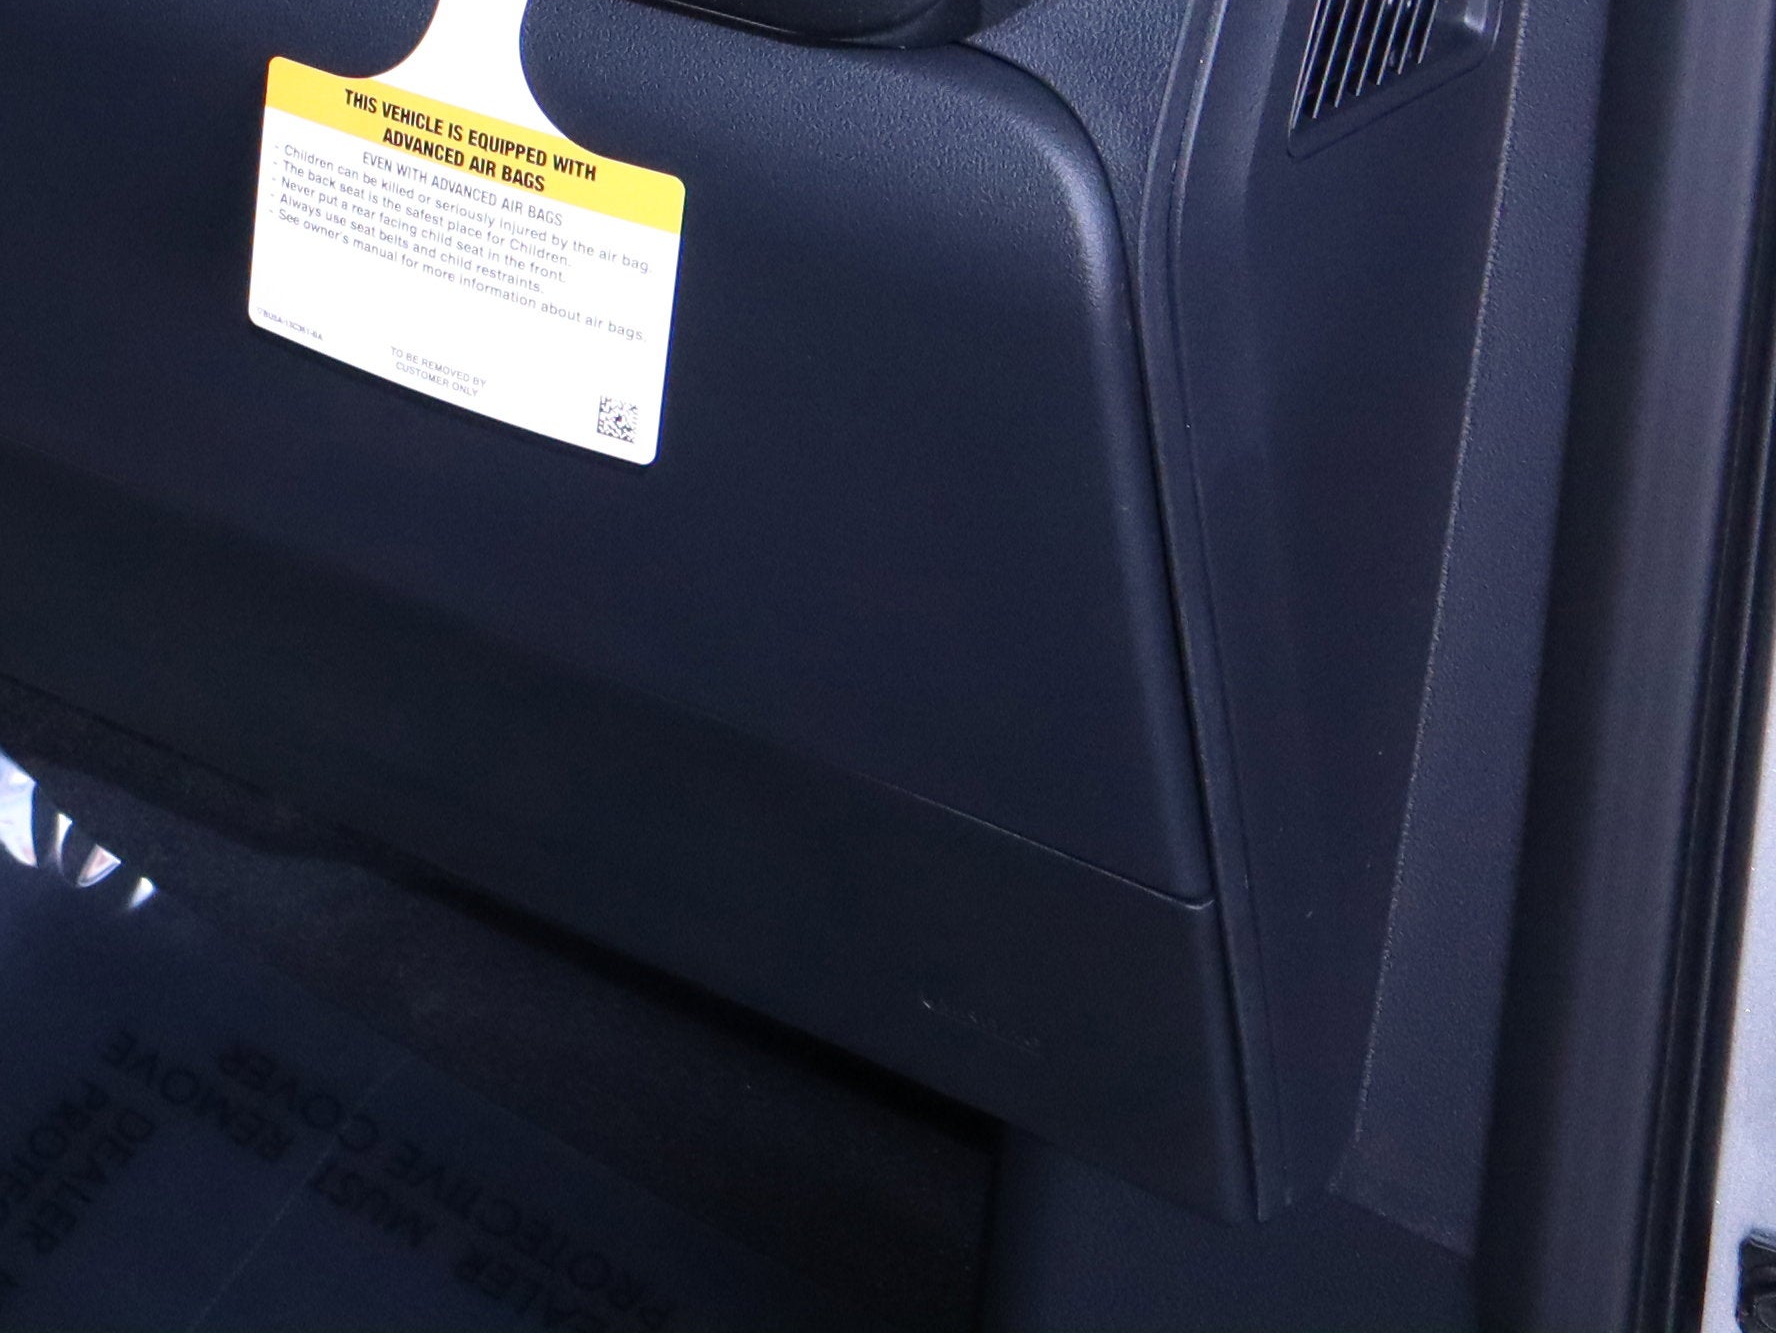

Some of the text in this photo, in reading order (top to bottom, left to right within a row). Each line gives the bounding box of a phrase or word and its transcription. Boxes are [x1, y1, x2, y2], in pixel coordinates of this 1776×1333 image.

[345, 88, 596, 181] THIS VEHICLE IS EQUIPPED WITH
[382, 127, 545, 192] ADVANCED AIR BAGS
[281, 176, 315, 196] Never
[318, 192, 338, 207] put
[341, 200, 348, 211] a
[352, 204, 376, 219] rear
[379, 211, 417, 238] facing
[421, 229, 453, 247] child
[456, 240, 484, 257] seat
[487, 248, 500, 262] in
[504, 254, 525, 270] the
[283, 159, 571, 267] The back seat is the safest place for Children.
[284, 144, 334, 171] Children
[337, 165, 359, 180] can
[362, 172, 378, 187] be
[381, 179, 415, 199] killed
[417, 193, 432, 204] or
[435, 199, 495, 227] seriously
[499, 218, 547, 242] injured
[551, 234, 569, 250] by
[573, 240, 595, 256] the
[598, 250, 617, 262] air
[362, 151, 562, 226] EVEN WITH ADVANCED AIR BAGS
[278, 208, 300, 226] See
[303, 220, 349, 245] owner's
[353, 238, 398, 261] manual
[401, 253, 419, 268] for
[422, 263, 455, 282] more
[459, 276, 537, 309] information
[540, 302, 581, 323] about
[585, 316, 603, 328] air
[280, 193, 541, 294] Always use seat belts and child restraints.
[390, 345, 486, 388] TO BE REMOVED BY
[395, 361, 478, 396] CUSTOMER ONLY
[100, 1028, 294, 1165] REMOVE
[216, 1041, 381, 1152] COVER
